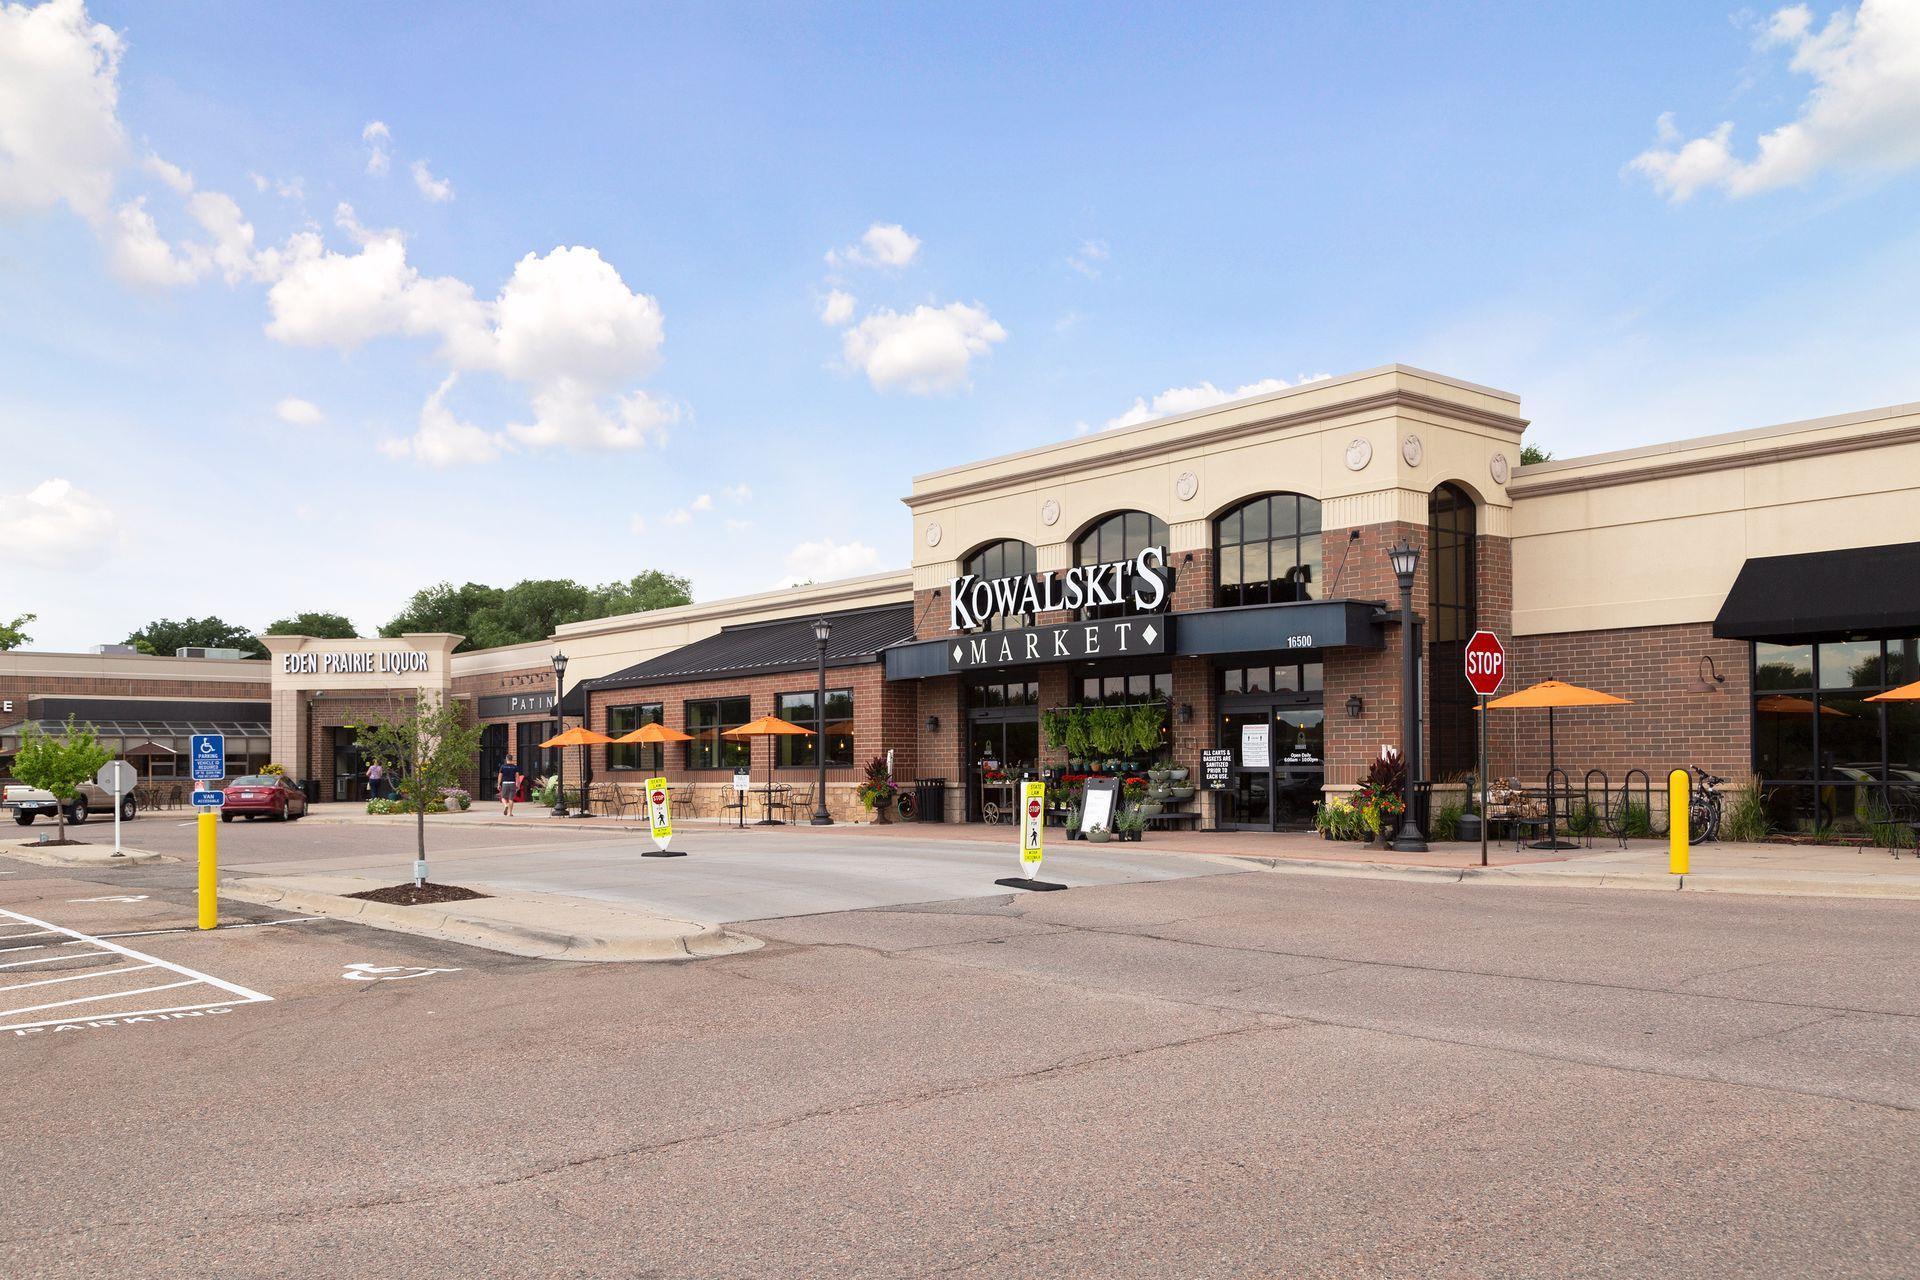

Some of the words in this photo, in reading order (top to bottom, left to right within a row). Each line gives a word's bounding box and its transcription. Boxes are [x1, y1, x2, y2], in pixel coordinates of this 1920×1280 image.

[948, 546, 1165, 630] KOWALSKI'S
[970, 623, 1131, 665] MARKET
[1287, 635, 1312, 648] 16500
[284, 654, 318, 673] EDEN
[323, 652, 374, 673] PRAIRIE
[379, 651, 428, 675] LIQUOR
[1468, 651, 1502, 675] STOP
[3, 700, 13, 712] E
[511, 696, 557, 711] PATIN
[1029, 805, 1040, 813] STOP
[14, 1007, 233, 1036] PARKING
